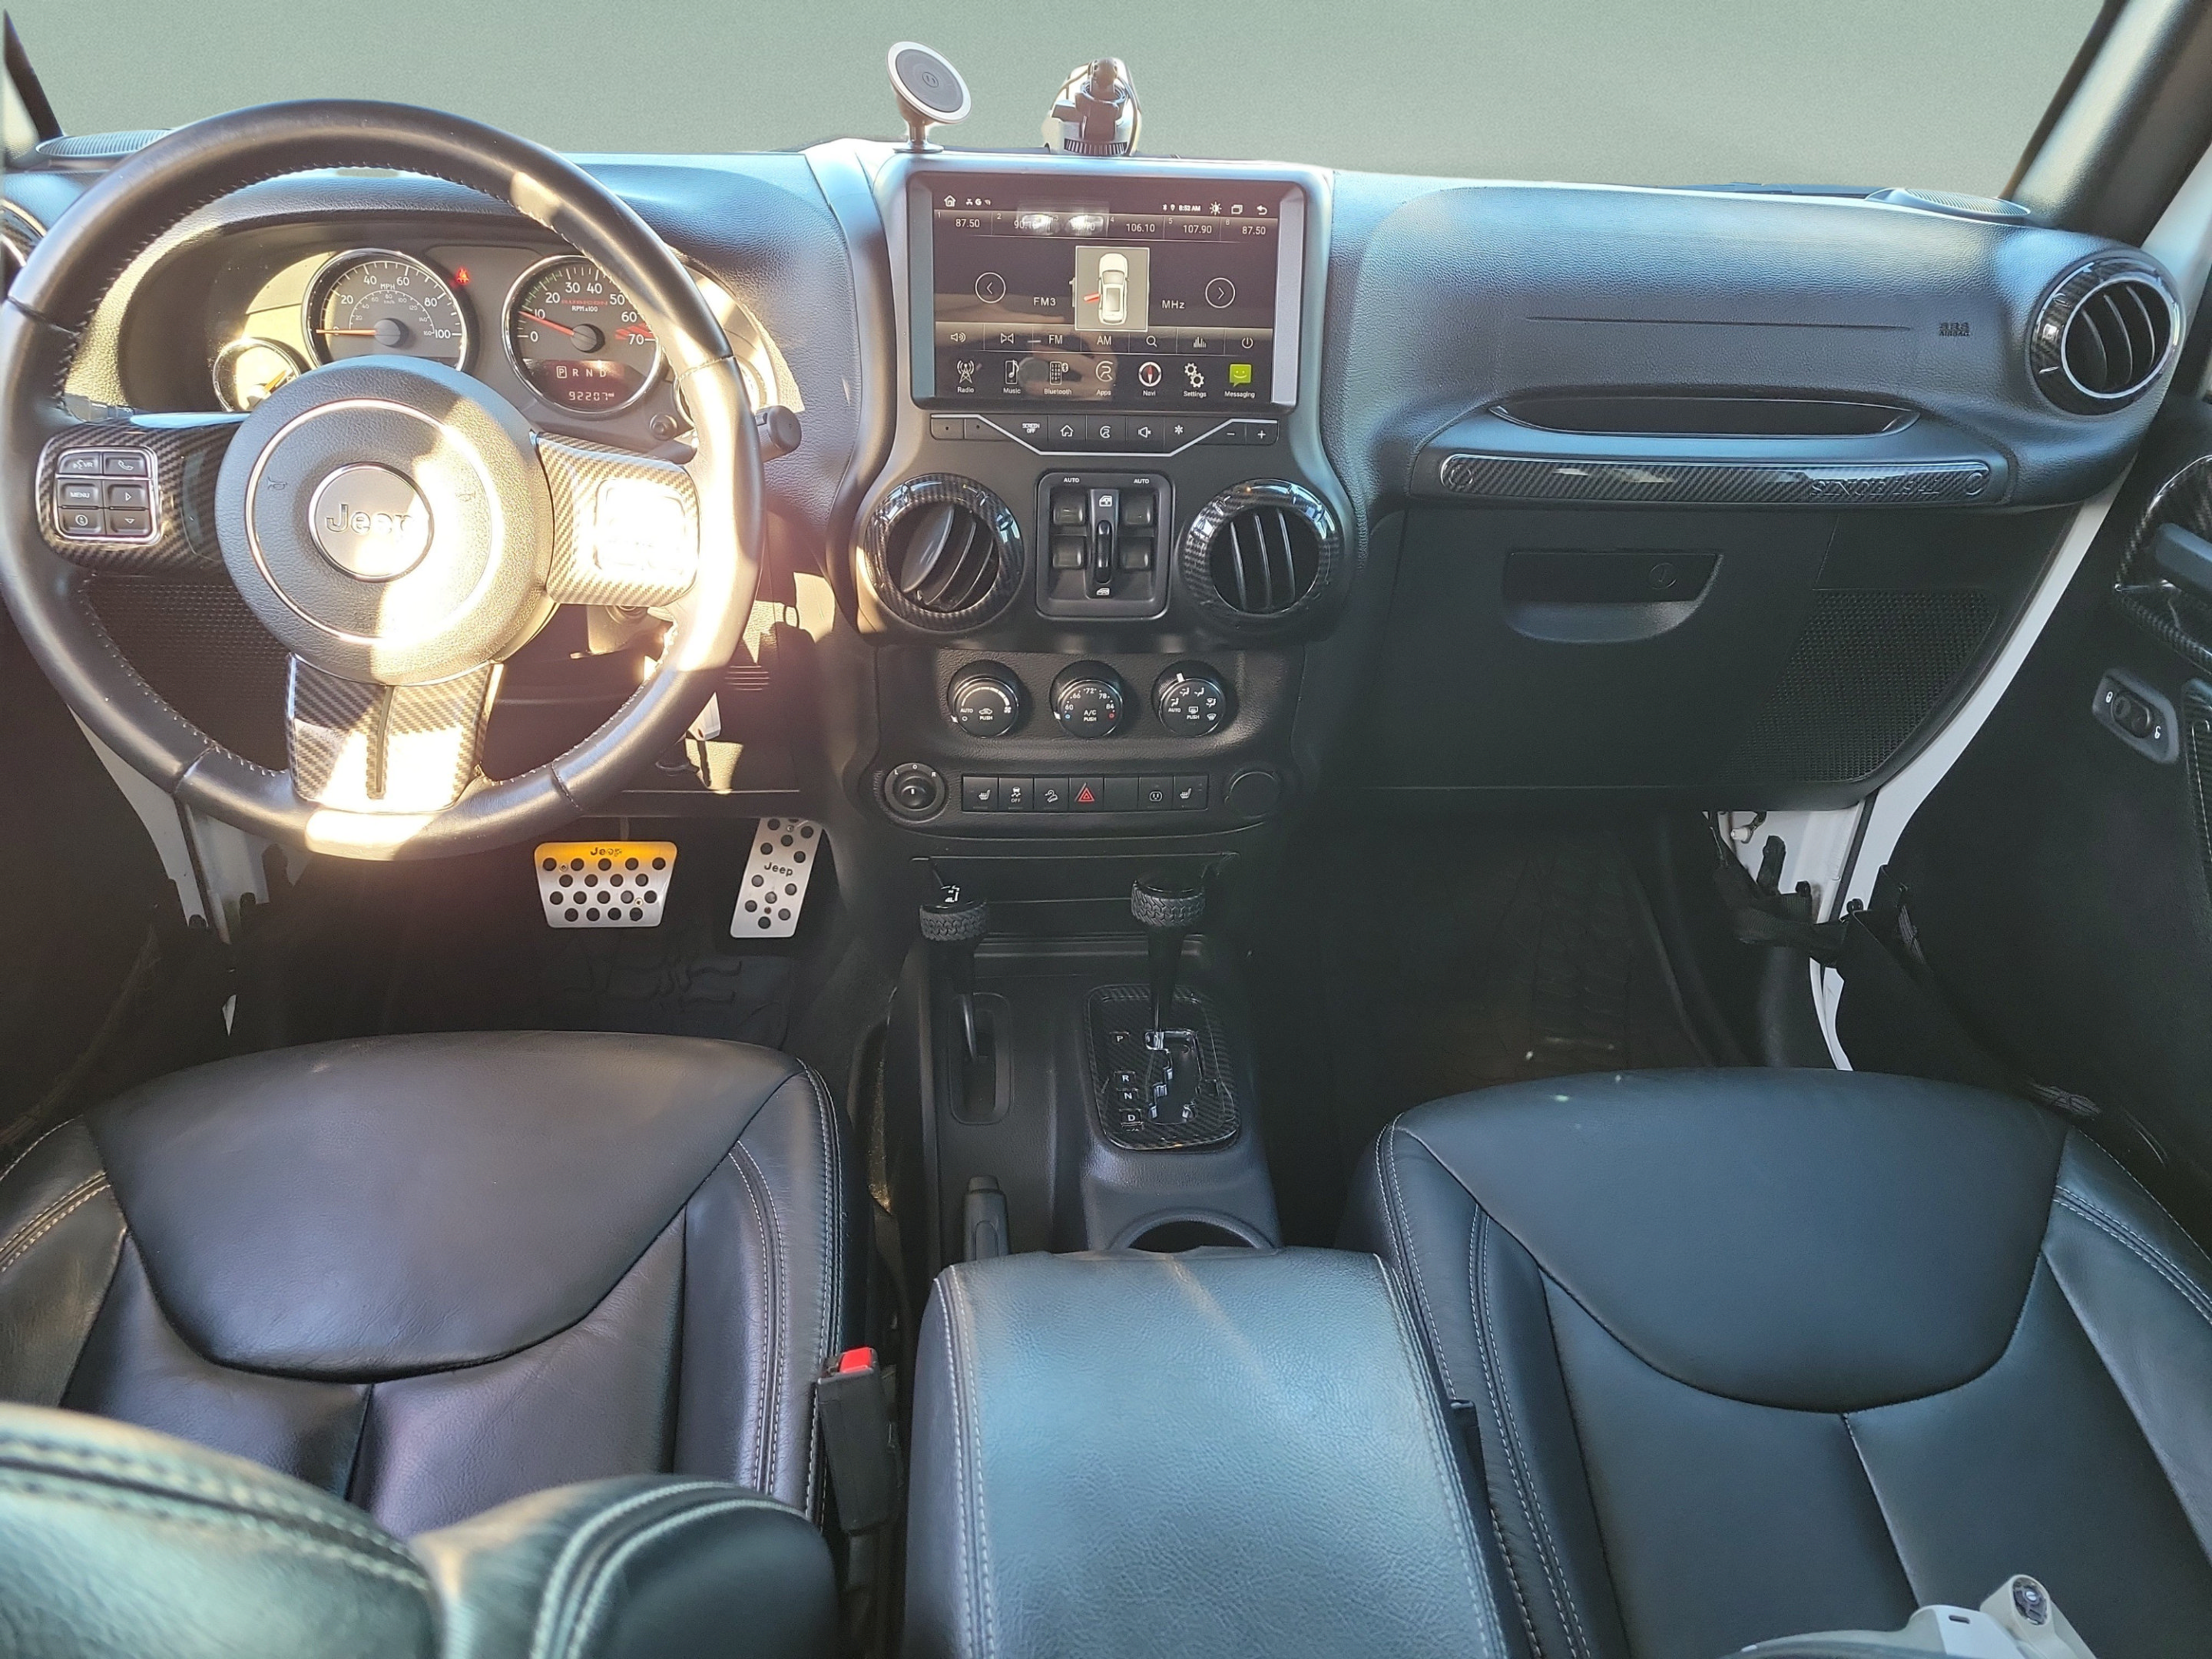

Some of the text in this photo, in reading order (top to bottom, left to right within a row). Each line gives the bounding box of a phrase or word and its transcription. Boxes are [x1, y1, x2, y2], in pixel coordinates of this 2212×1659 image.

[955, 218, 980, 228] 87.50
[1125, 223, 1155, 233] 106.10
[1183, 224, 1213, 234] 107.90
[1242, 226, 1267, 235] 87.50
[363, 275, 377, 286] 40
[396, 276, 410, 286] 60
[565, 282, 581, 293] 30
[587, 283, 603, 294] 40
[340, 295, 354, 305] 20
[424, 296, 438, 307] 80
[545, 292, 561, 303] 20
[610, 294, 625, 306] 50
[1033, 297, 1056, 306] FM3
[1161, 300, 1185, 310] MHz
[534, 309, 545, 320] 10
[621, 311, 637, 323] 60
[434, 329, 451, 339] 100
[530, 331, 538, 343] 0
[628, 333, 644, 345] 70
[1048, 334, 1063, 345] FM
[1097, 335, 1112, 346] AM
[572, 368, 579, 377] R
[585, 369, 593, 377] N
[599, 369, 607, 378] D
[568, 391, 608, 401] 92207
[763, 861, 793, 876] Jeep
